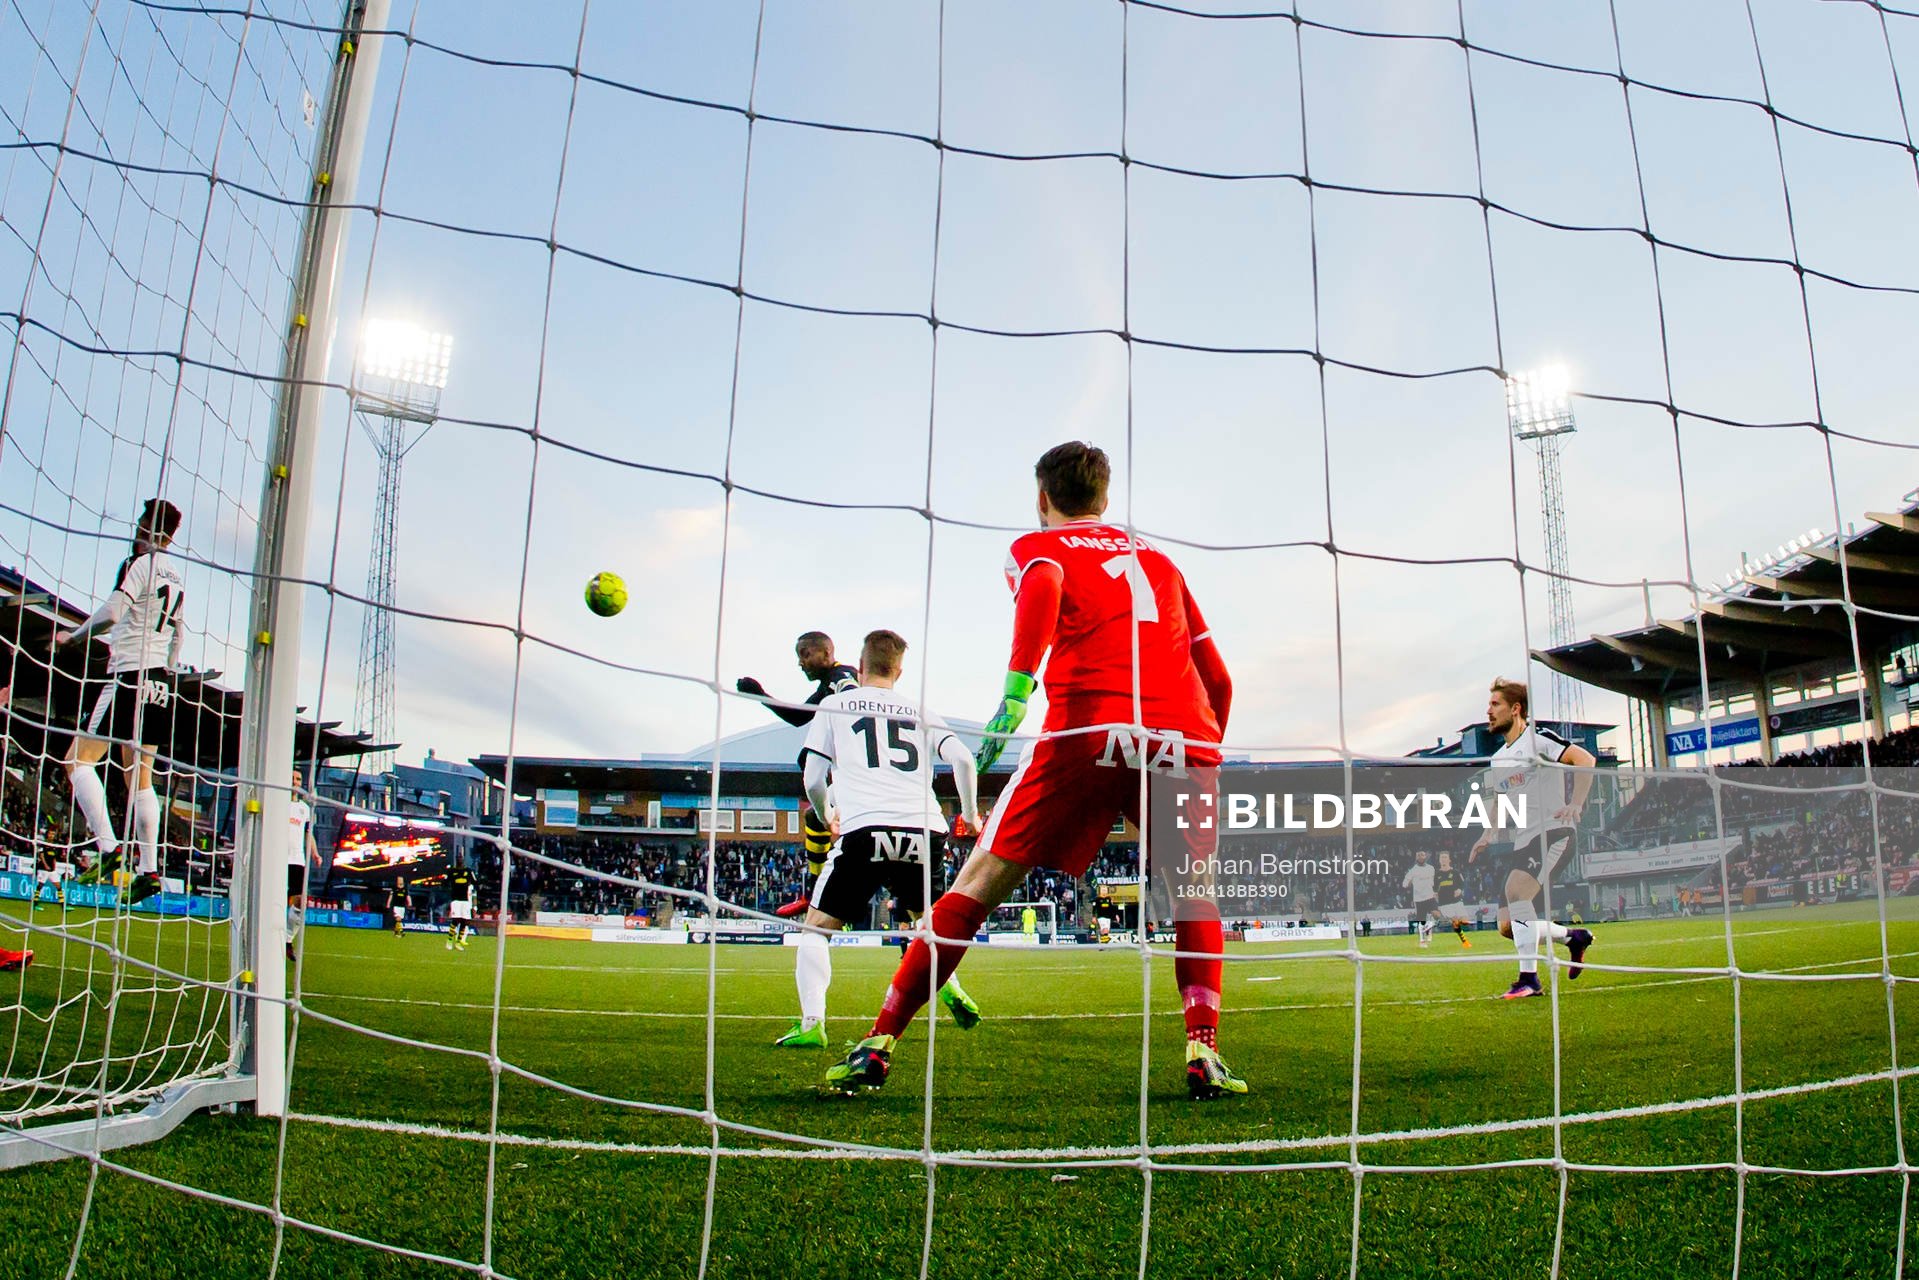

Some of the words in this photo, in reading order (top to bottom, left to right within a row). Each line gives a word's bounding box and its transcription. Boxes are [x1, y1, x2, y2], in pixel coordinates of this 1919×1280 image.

[1101, 553, 1159, 623] 1
[851, 716, 919, 772] 15
[1096, 728, 1189, 779] NA
[1672, 735, 1695, 752] NA
[870, 831, 925, 865] NA
